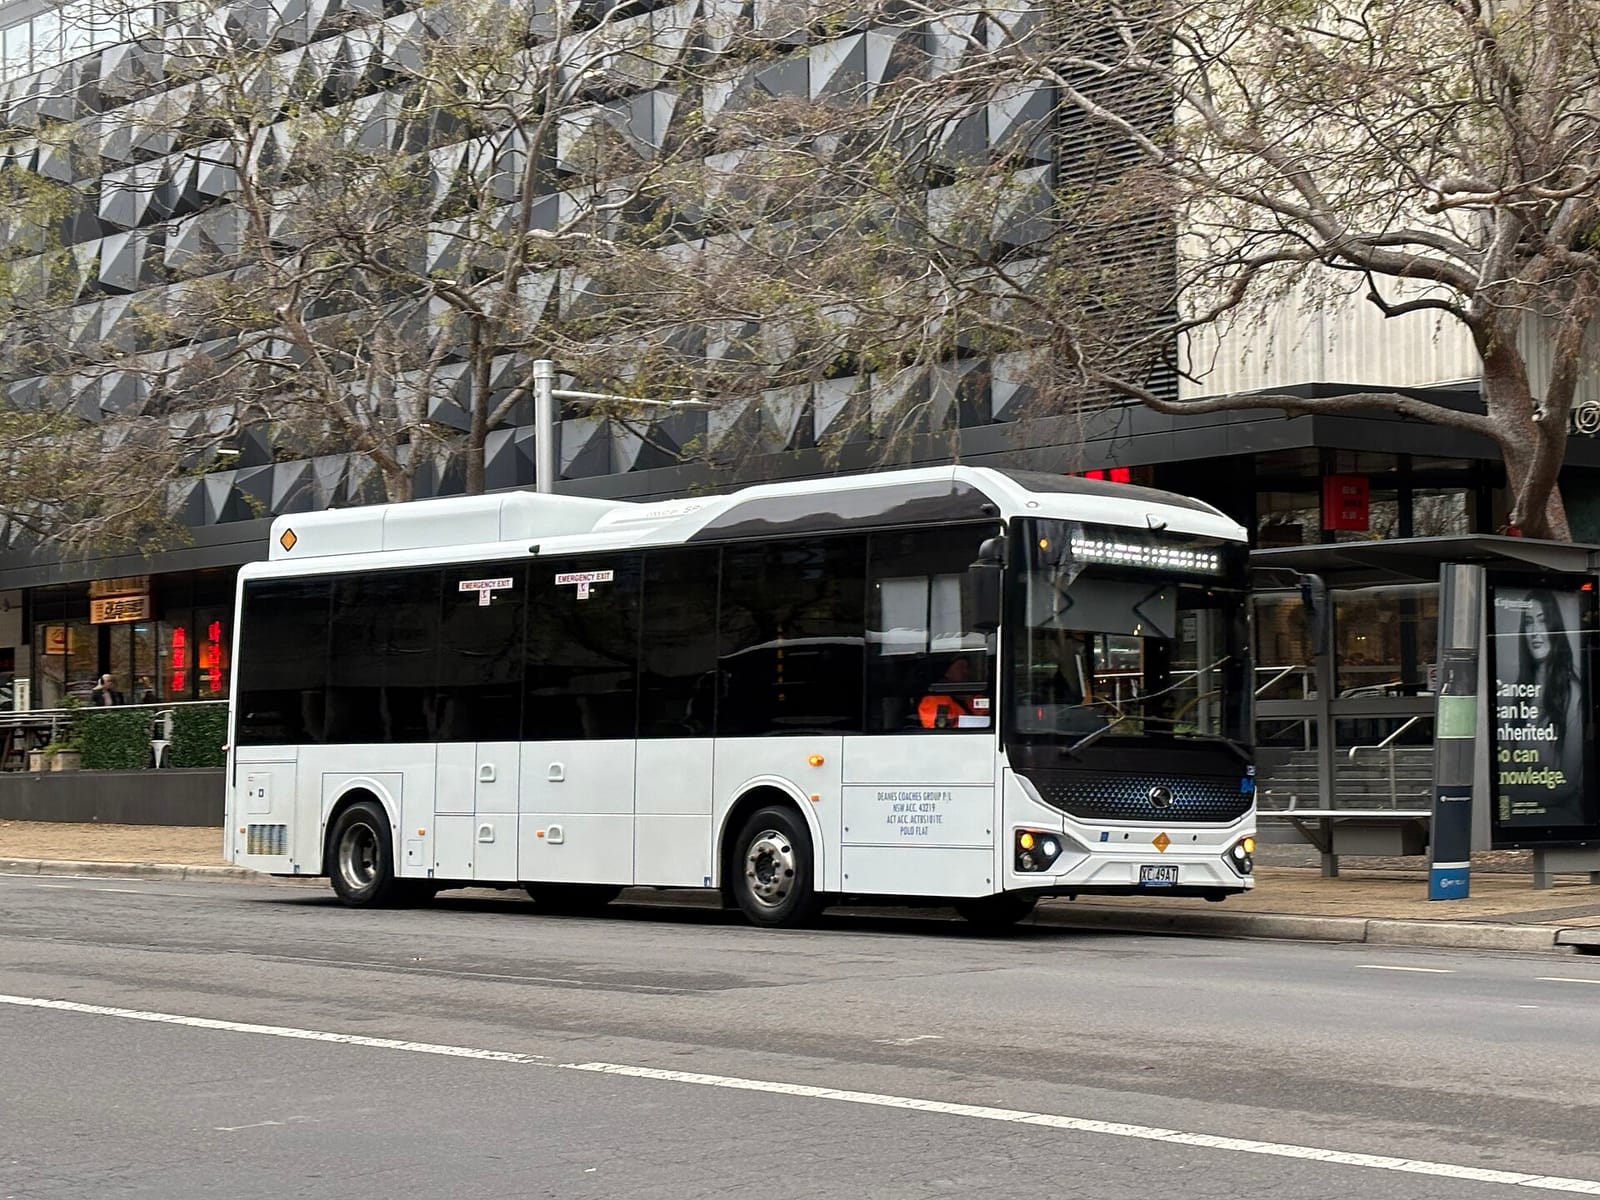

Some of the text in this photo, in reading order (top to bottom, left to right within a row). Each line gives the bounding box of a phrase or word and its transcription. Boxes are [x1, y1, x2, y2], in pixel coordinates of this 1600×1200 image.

[559, 572, 611, 583] EMERGENCY EXIT
[461, 579, 511, 590] EMERGENCY EXIT
[1520, 701, 1539, 719] be
[1496, 722, 1559, 742] nherited.
[1512, 748, 1540, 763] can
[1498, 766, 1567, 789] nowledge.
[877, 792, 897, 801] DEANES
[898, 792, 921, 801] COACHES
[923, 792, 941, 801] GROUP
[893, 803, 904, 812] NSW
[886, 814, 896, 824] ACT
[900, 826, 928, 836] POLO FLAT
